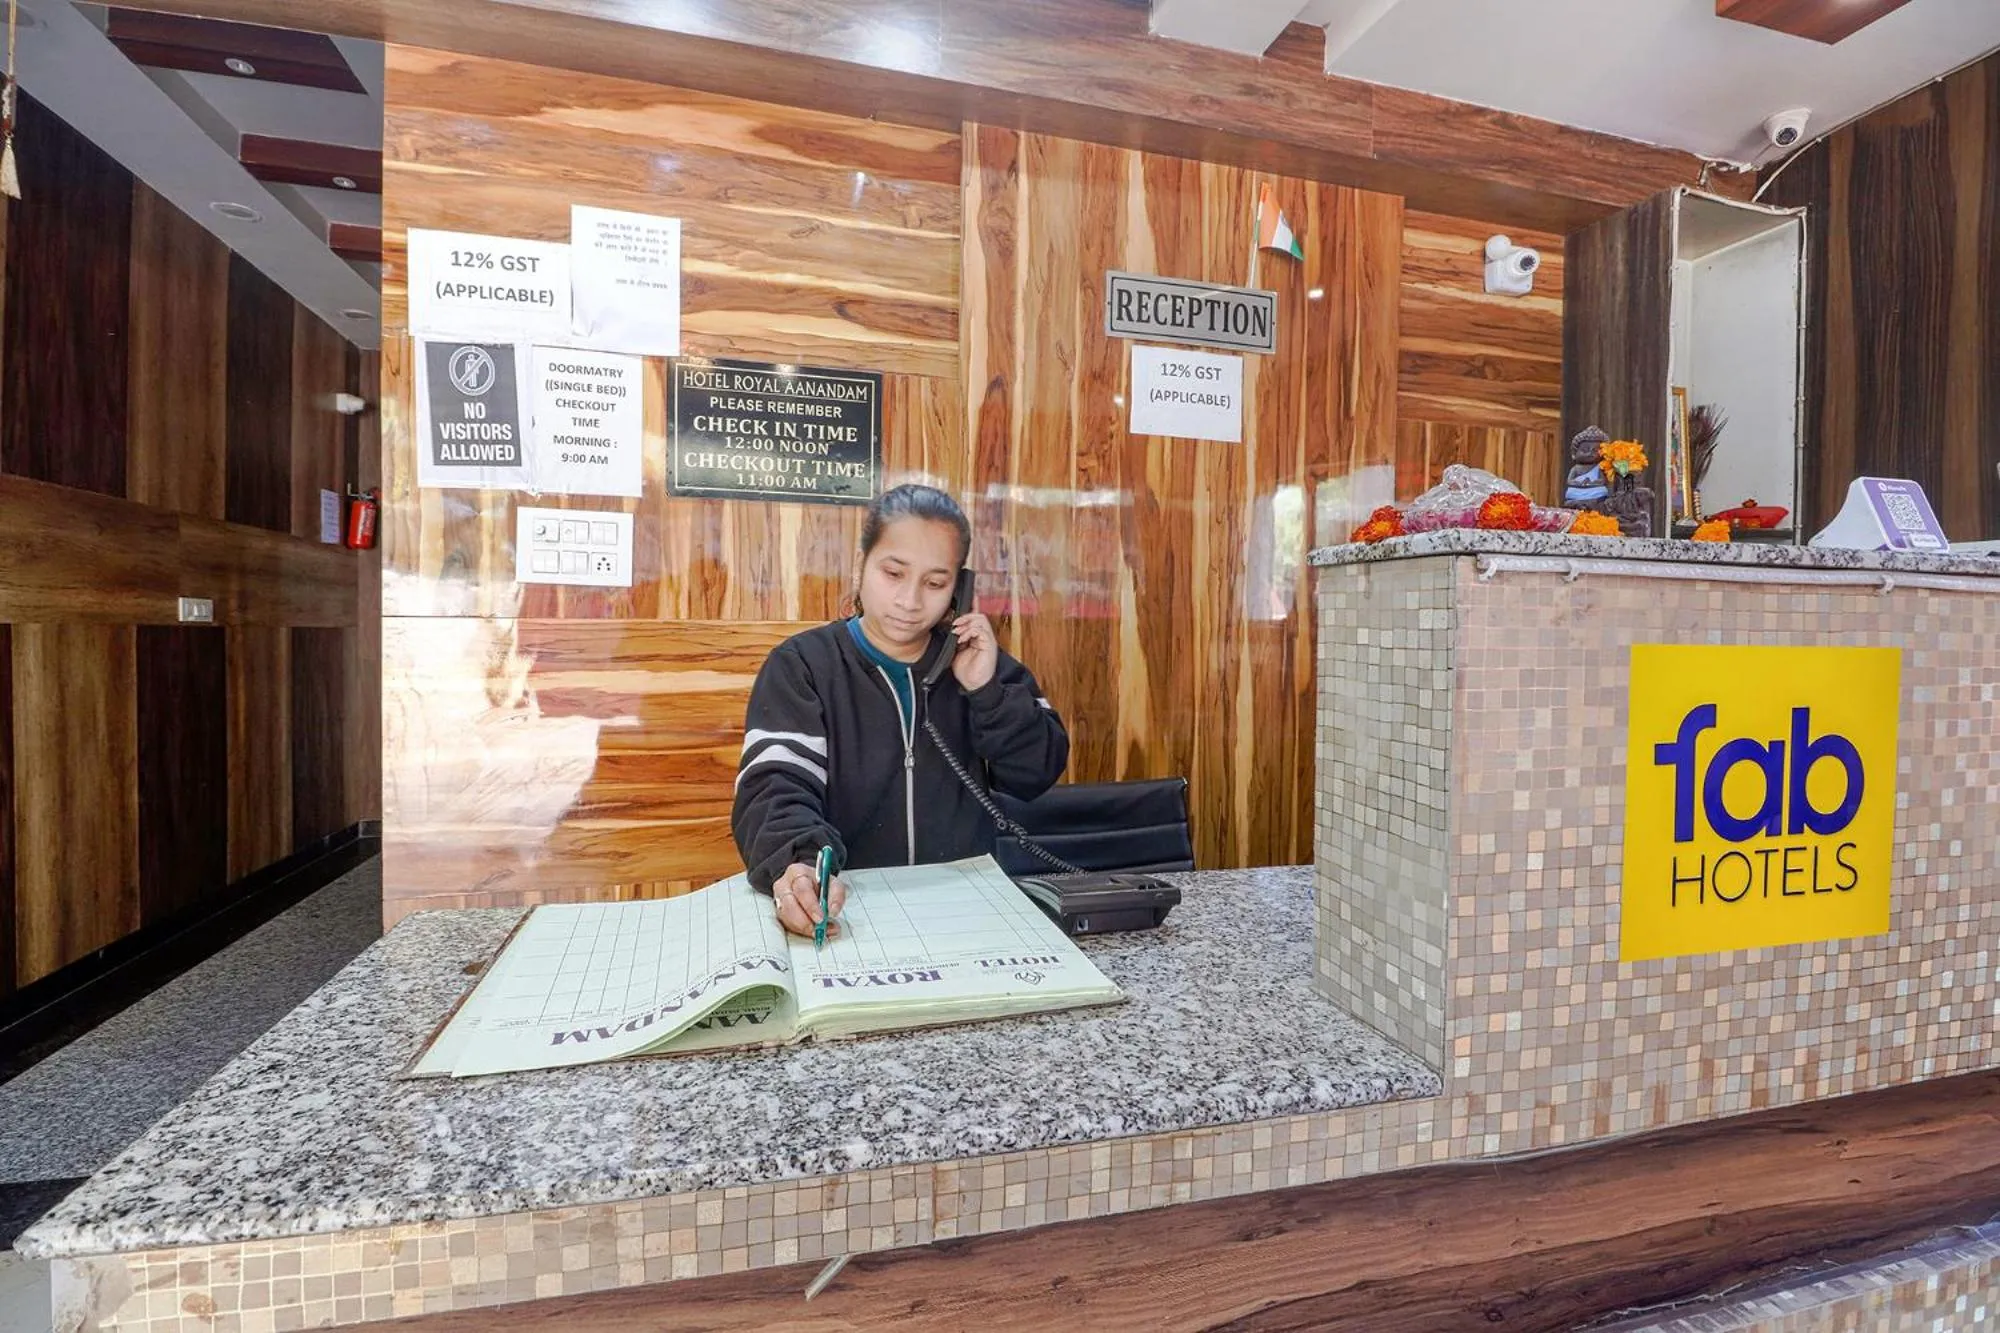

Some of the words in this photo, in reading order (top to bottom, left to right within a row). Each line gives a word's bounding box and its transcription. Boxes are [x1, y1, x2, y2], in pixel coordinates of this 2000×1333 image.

[450, 250, 494, 270] 12%
[500, 255, 540, 273] GST
[435, 281, 555, 307] (APPLICABLE)
[1116, 288, 1268, 337] RECEPTION
[548, 362, 624, 379] DOORMATRY
[1160, 363, 1191, 379] 12%
[1195, 366, 1222, 381] GST
[545, 379, 593, 393] ((SINGLE
[596, 383, 627, 398] BED))
[683, 370, 730, 389] HOTEL
[734, 374, 780, 393] ROYAL
[784, 380, 868, 400] AANANDAM
[555, 398, 616, 413] CHECKOUT
[710, 396, 763, 412] PLEASE
[767, 400, 842, 418] REMEMBER
[1150, 388, 1231, 410] (APPLICABLE)
[463, 402, 486, 420] NO
[439, 422, 513, 440] VISITORS
[571, 416, 601, 428] TIME
[693, 415, 769, 436] CHECK
[774, 421, 797, 438] IN
[803, 423, 859, 442] TIME
[553, 435, 611, 448] MORNING
[724, 436, 774, 451] 12:00
[779, 439, 830, 456] NOON
[440, 443, 515, 461] ALLOWED
[561, 453, 586, 463] 9:00
[588, 454, 609, 464] AM
[684, 452, 806, 474] CHECKOUT
[811, 460, 866, 478] TIME
[736, 474, 786, 488] 11:00
[790, 476, 818, 490] AM
[1653, 703, 1866, 843] fab
[1671, 842, 1859, 907] HOTELS
[974, 956, 1060, 967] HOTEL
[811, 969, 944, 988] ROYAL
